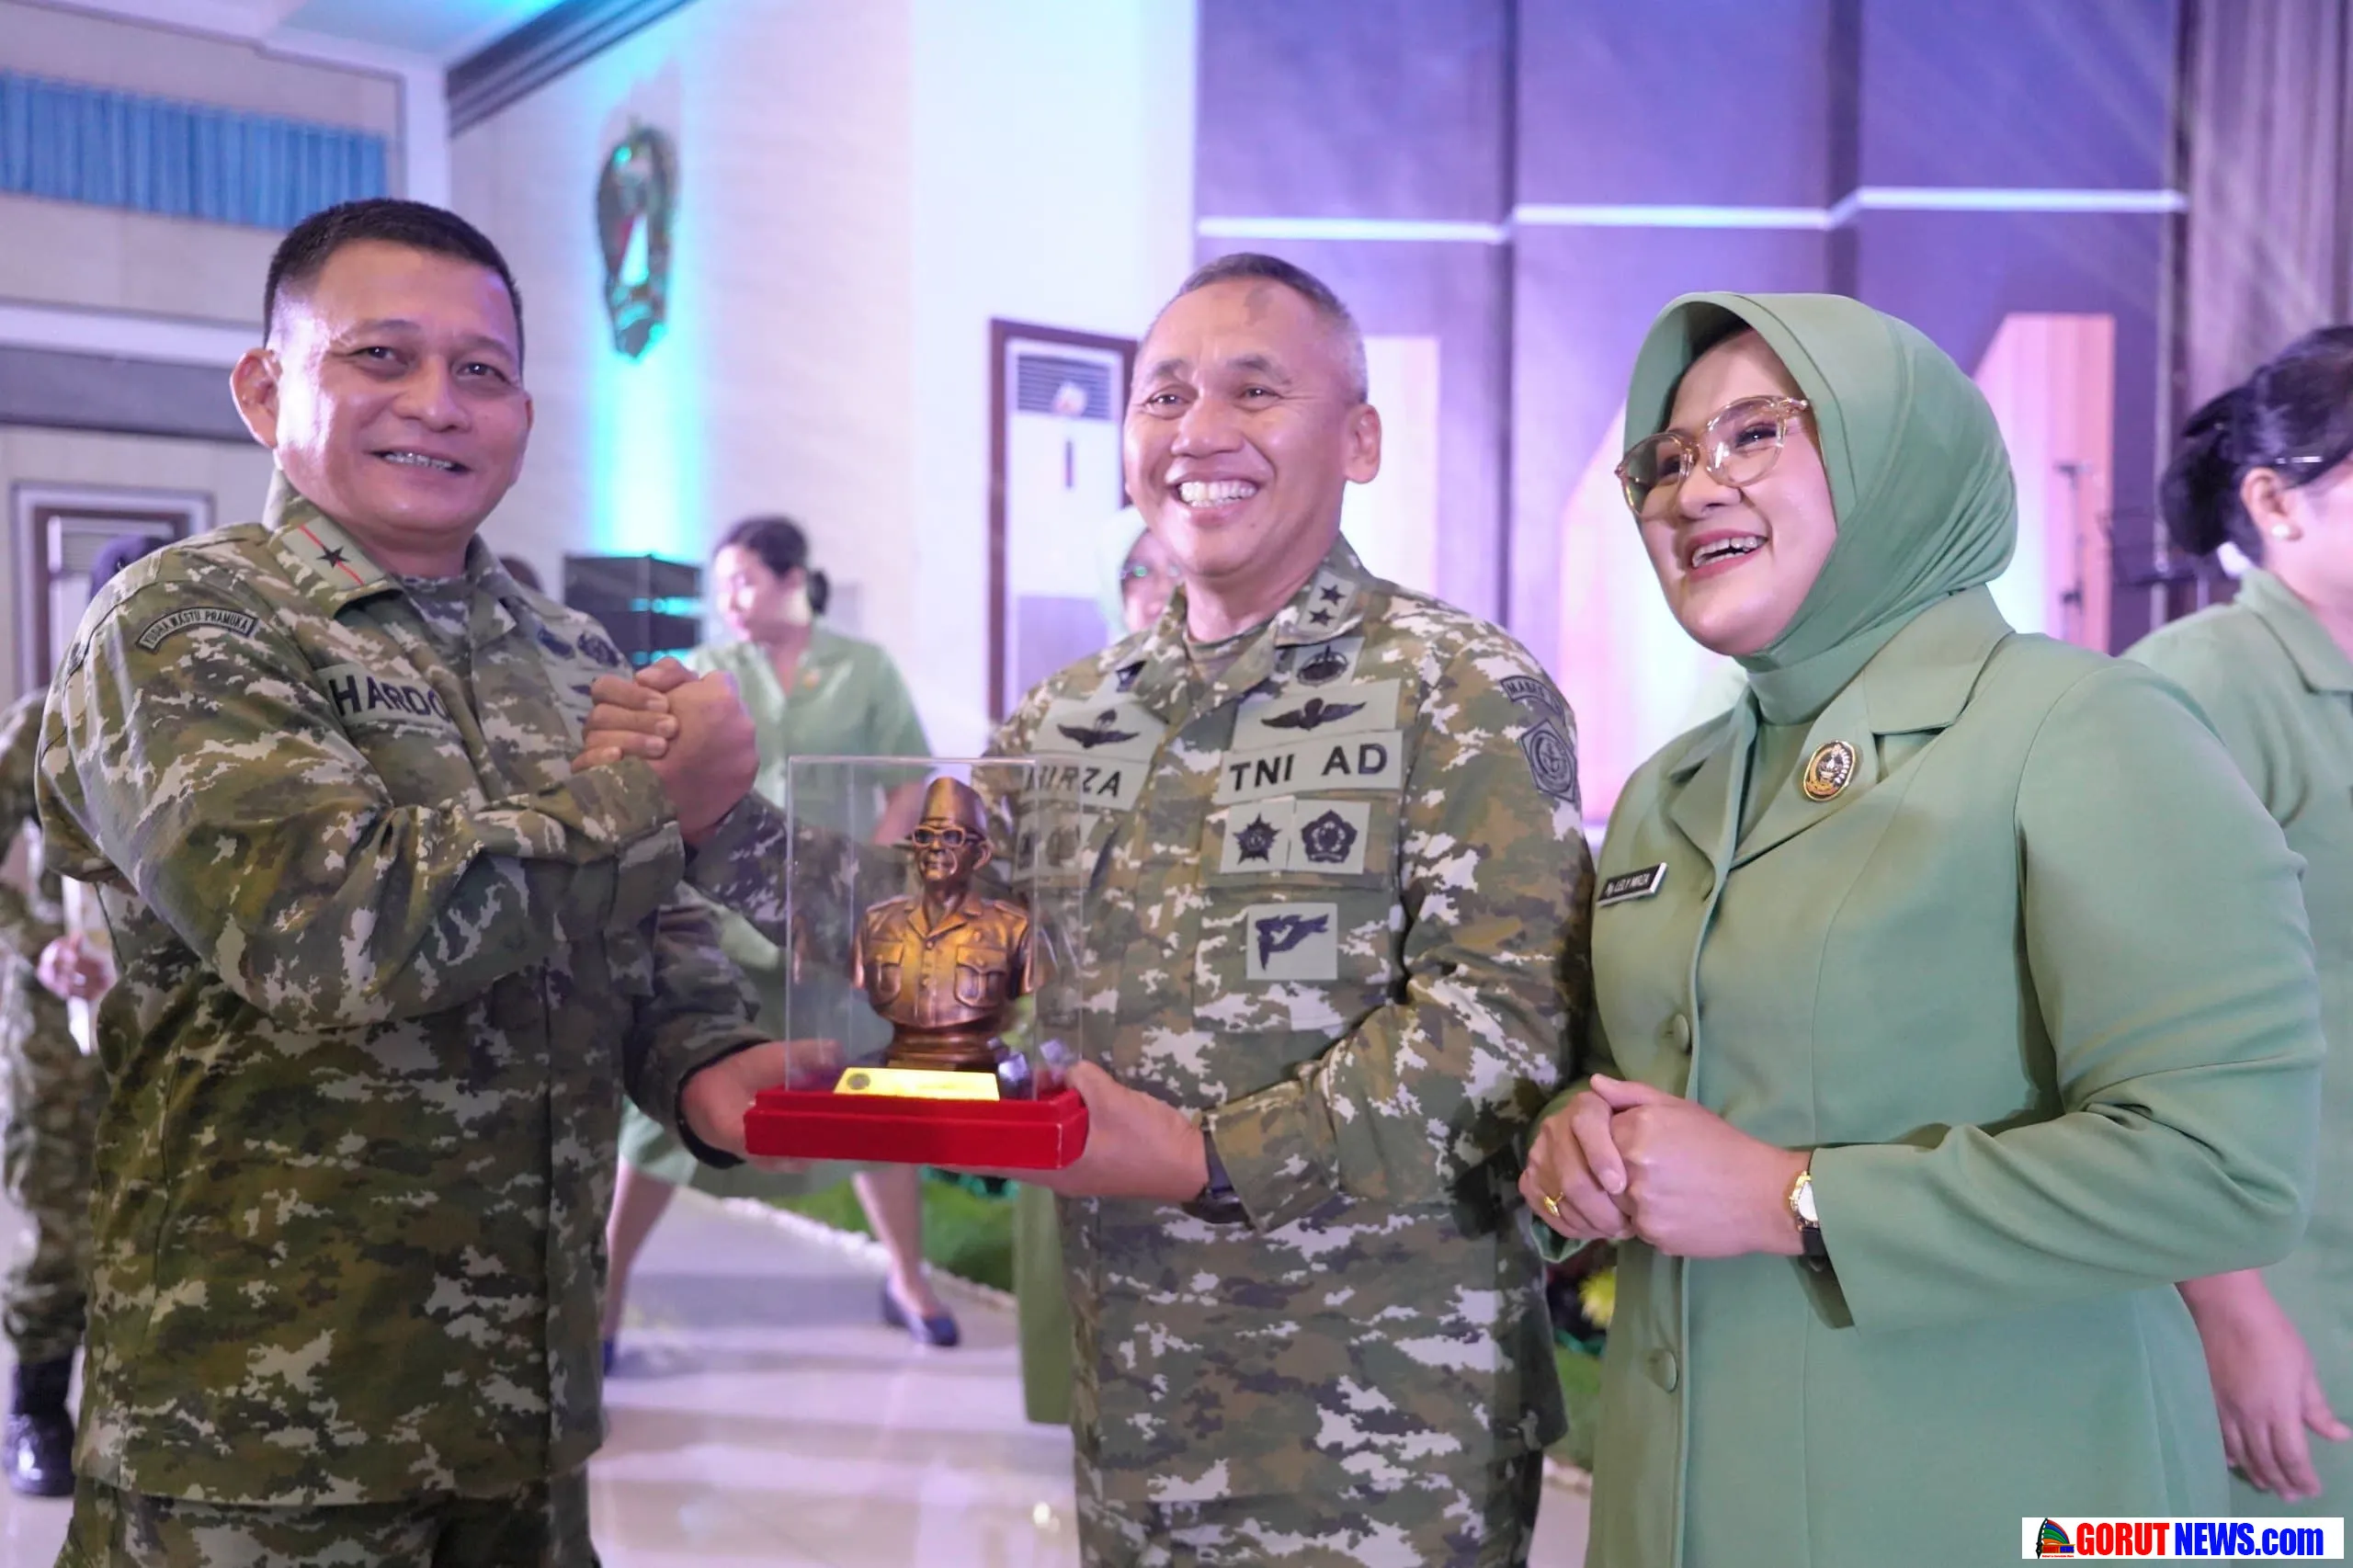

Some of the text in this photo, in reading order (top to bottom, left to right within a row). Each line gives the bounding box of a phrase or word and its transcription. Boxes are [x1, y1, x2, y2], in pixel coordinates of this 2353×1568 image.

[205, 610, 247, 631] PRAMUKA
[1229, 743, 1388, 791] TNI AD
